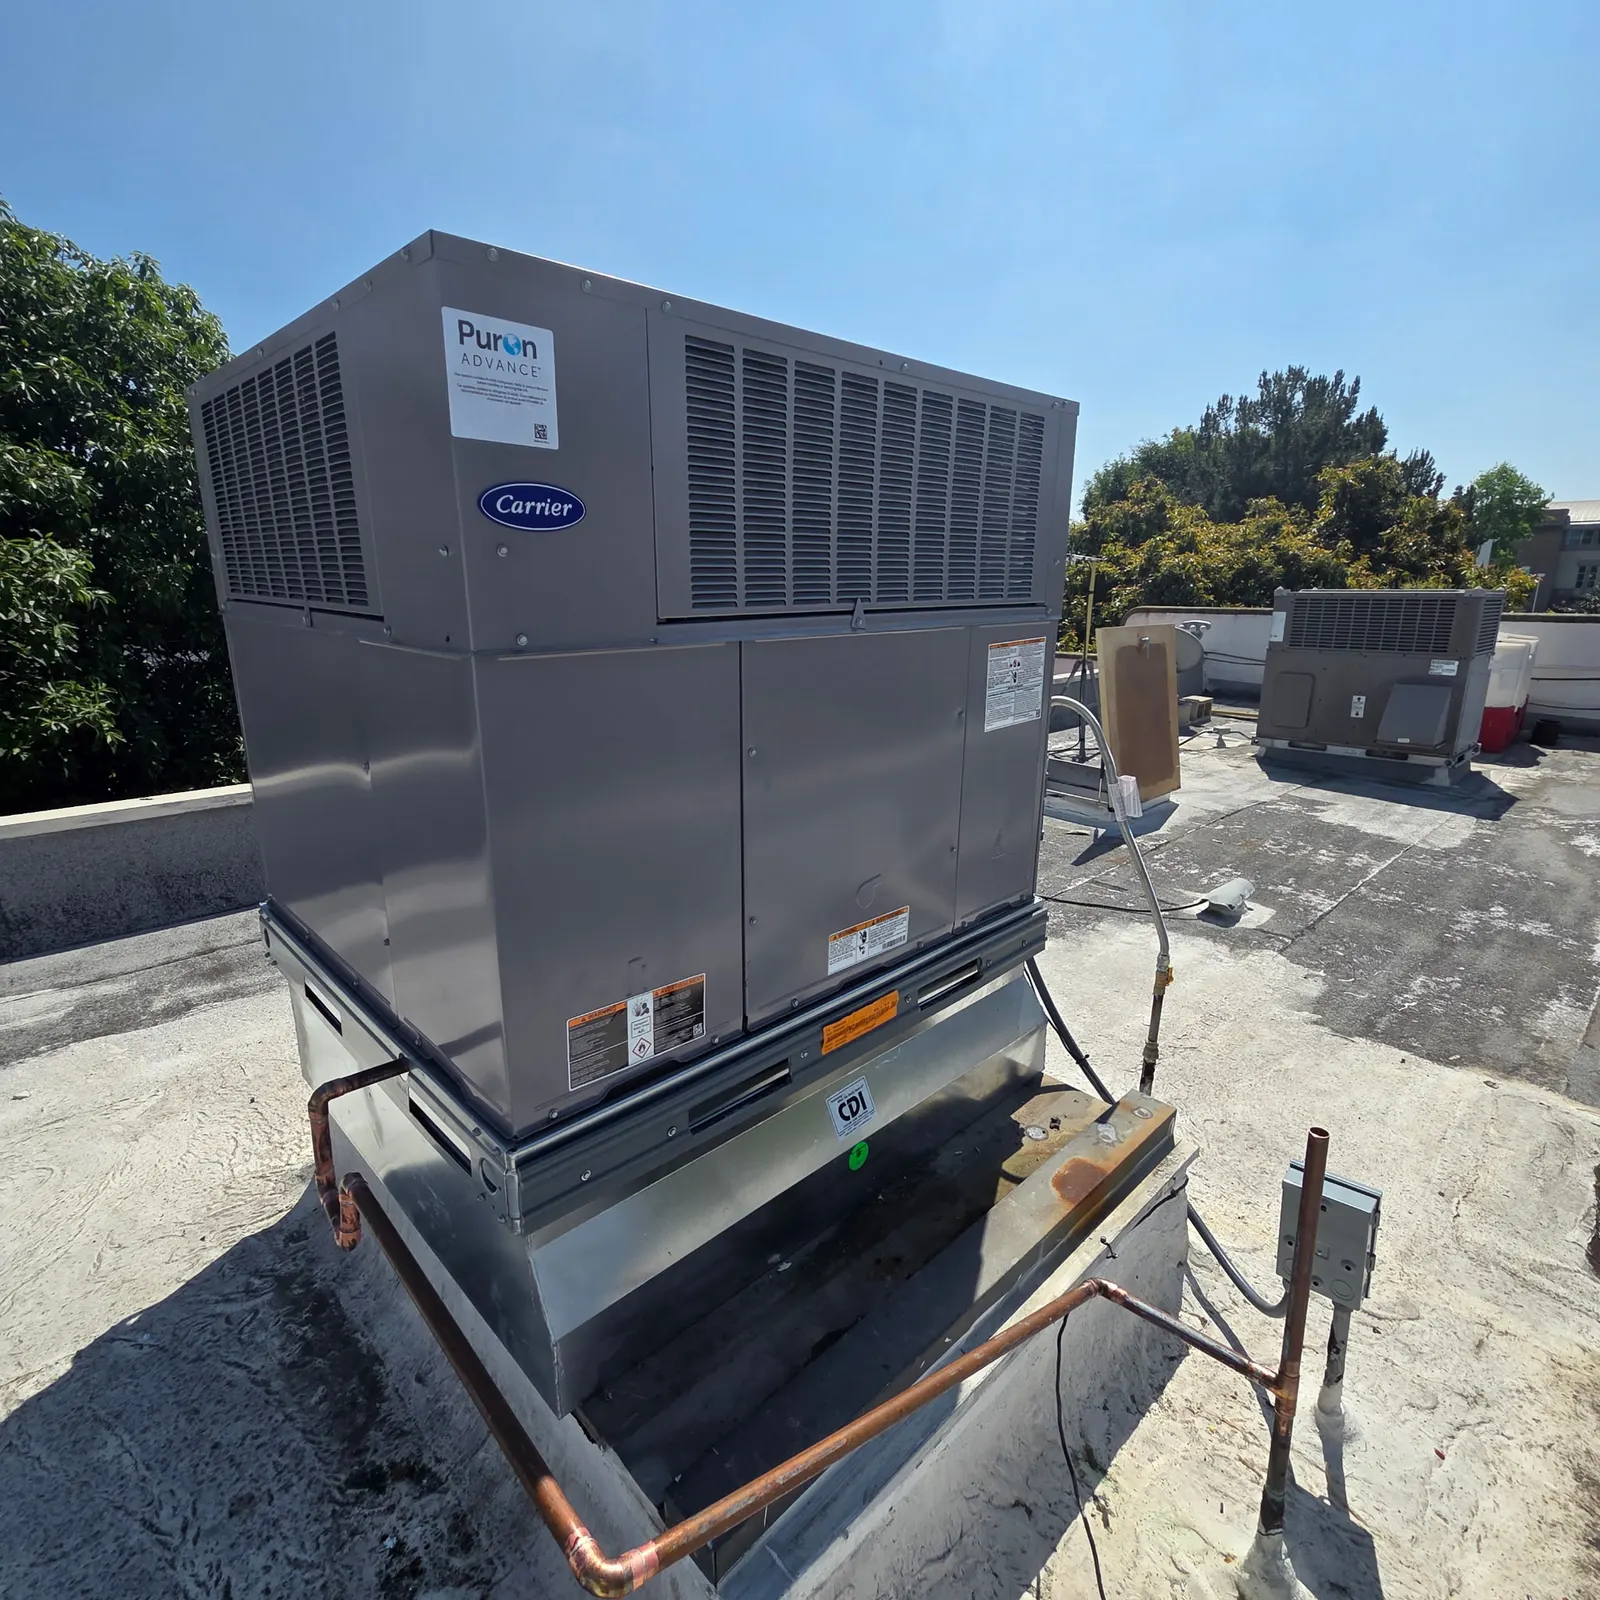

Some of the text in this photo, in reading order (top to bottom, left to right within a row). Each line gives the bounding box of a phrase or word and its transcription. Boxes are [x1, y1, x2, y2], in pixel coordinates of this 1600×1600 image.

[457, 319, 537, 359] Puron
[495, 494, 573, 517] Carrier
[838, 1091, 867, 1121] CDI
